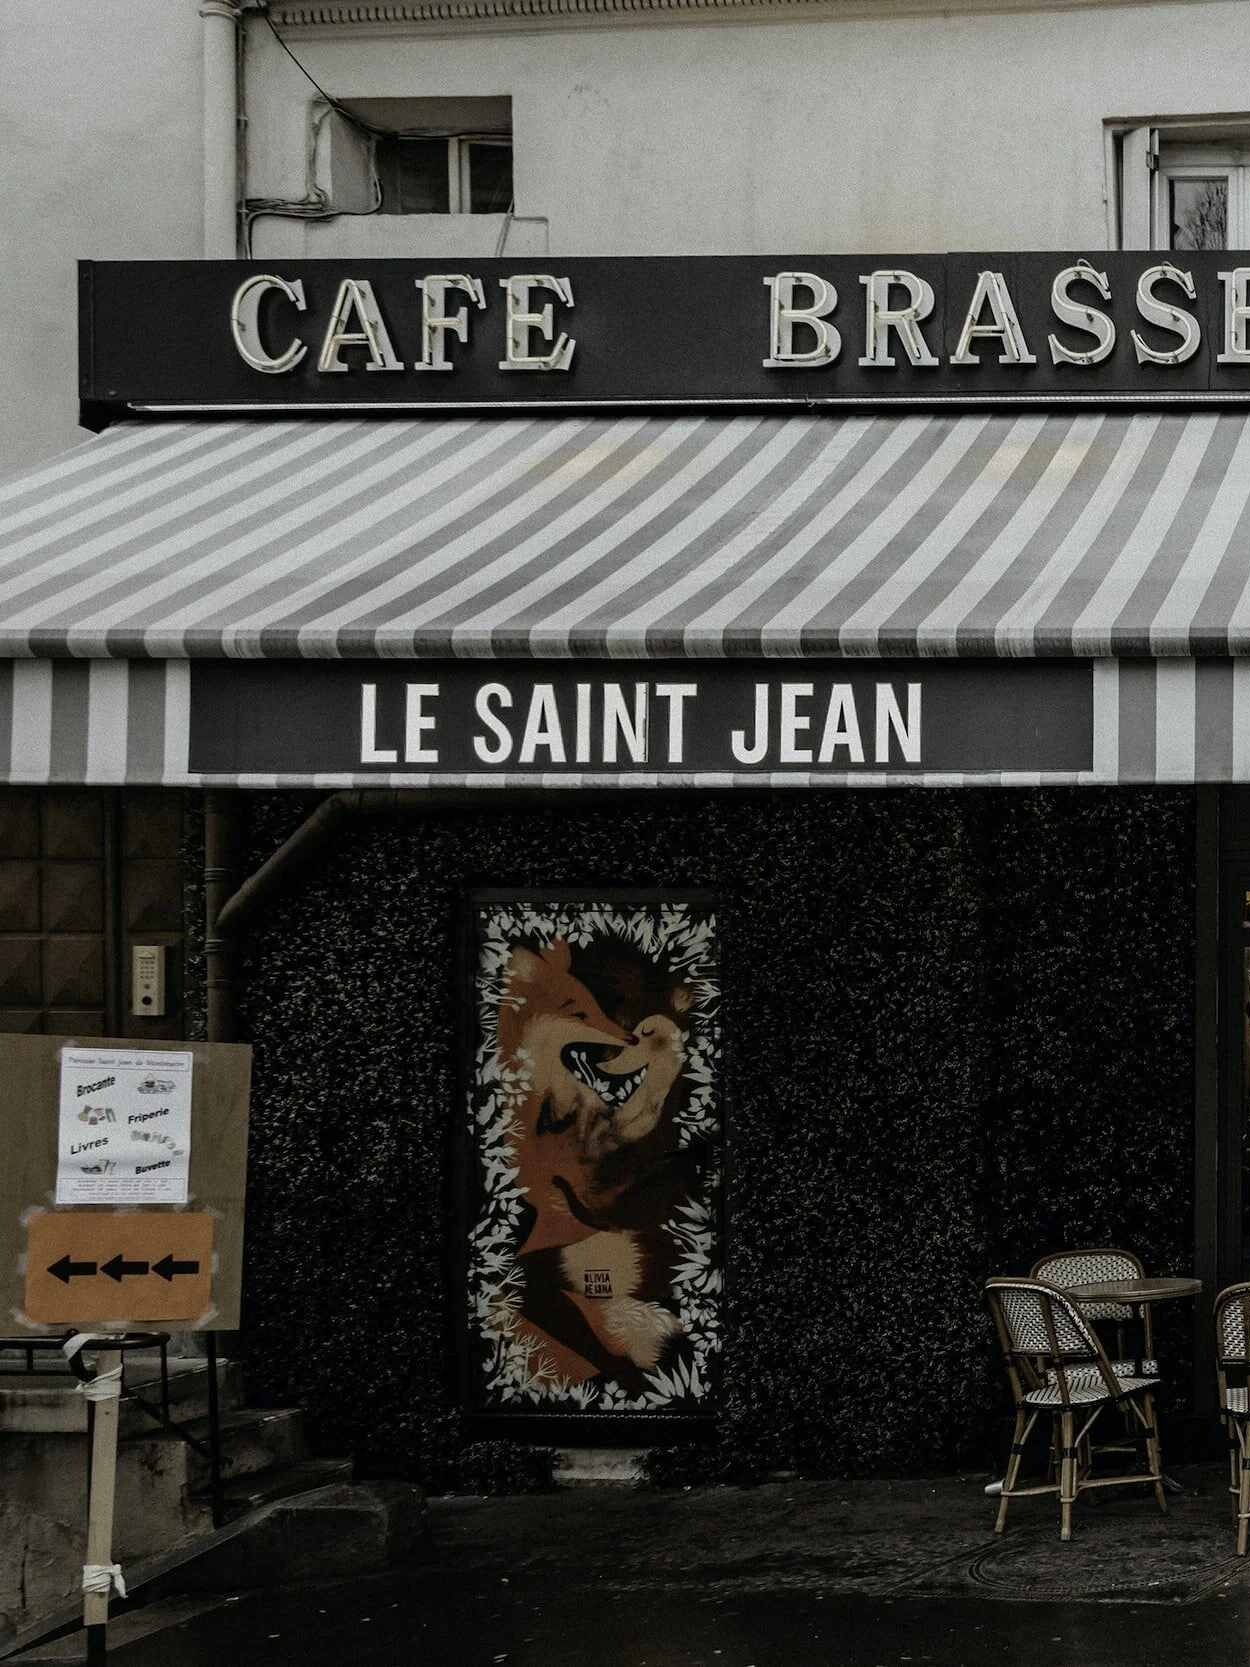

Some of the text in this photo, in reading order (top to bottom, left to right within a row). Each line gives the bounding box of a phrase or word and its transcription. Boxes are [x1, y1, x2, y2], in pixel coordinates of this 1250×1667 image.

[232, 274, 576, 374] CAFE
[360, 682, 922, 764] LE SAINT JEAN
[77, 1076, 116, 1097] Brocante
[128, 1107, 170, 1125] Friperie
[70, 1136, 109, 1155] Livres
[135, 1160, 171, 1175] Buvette
